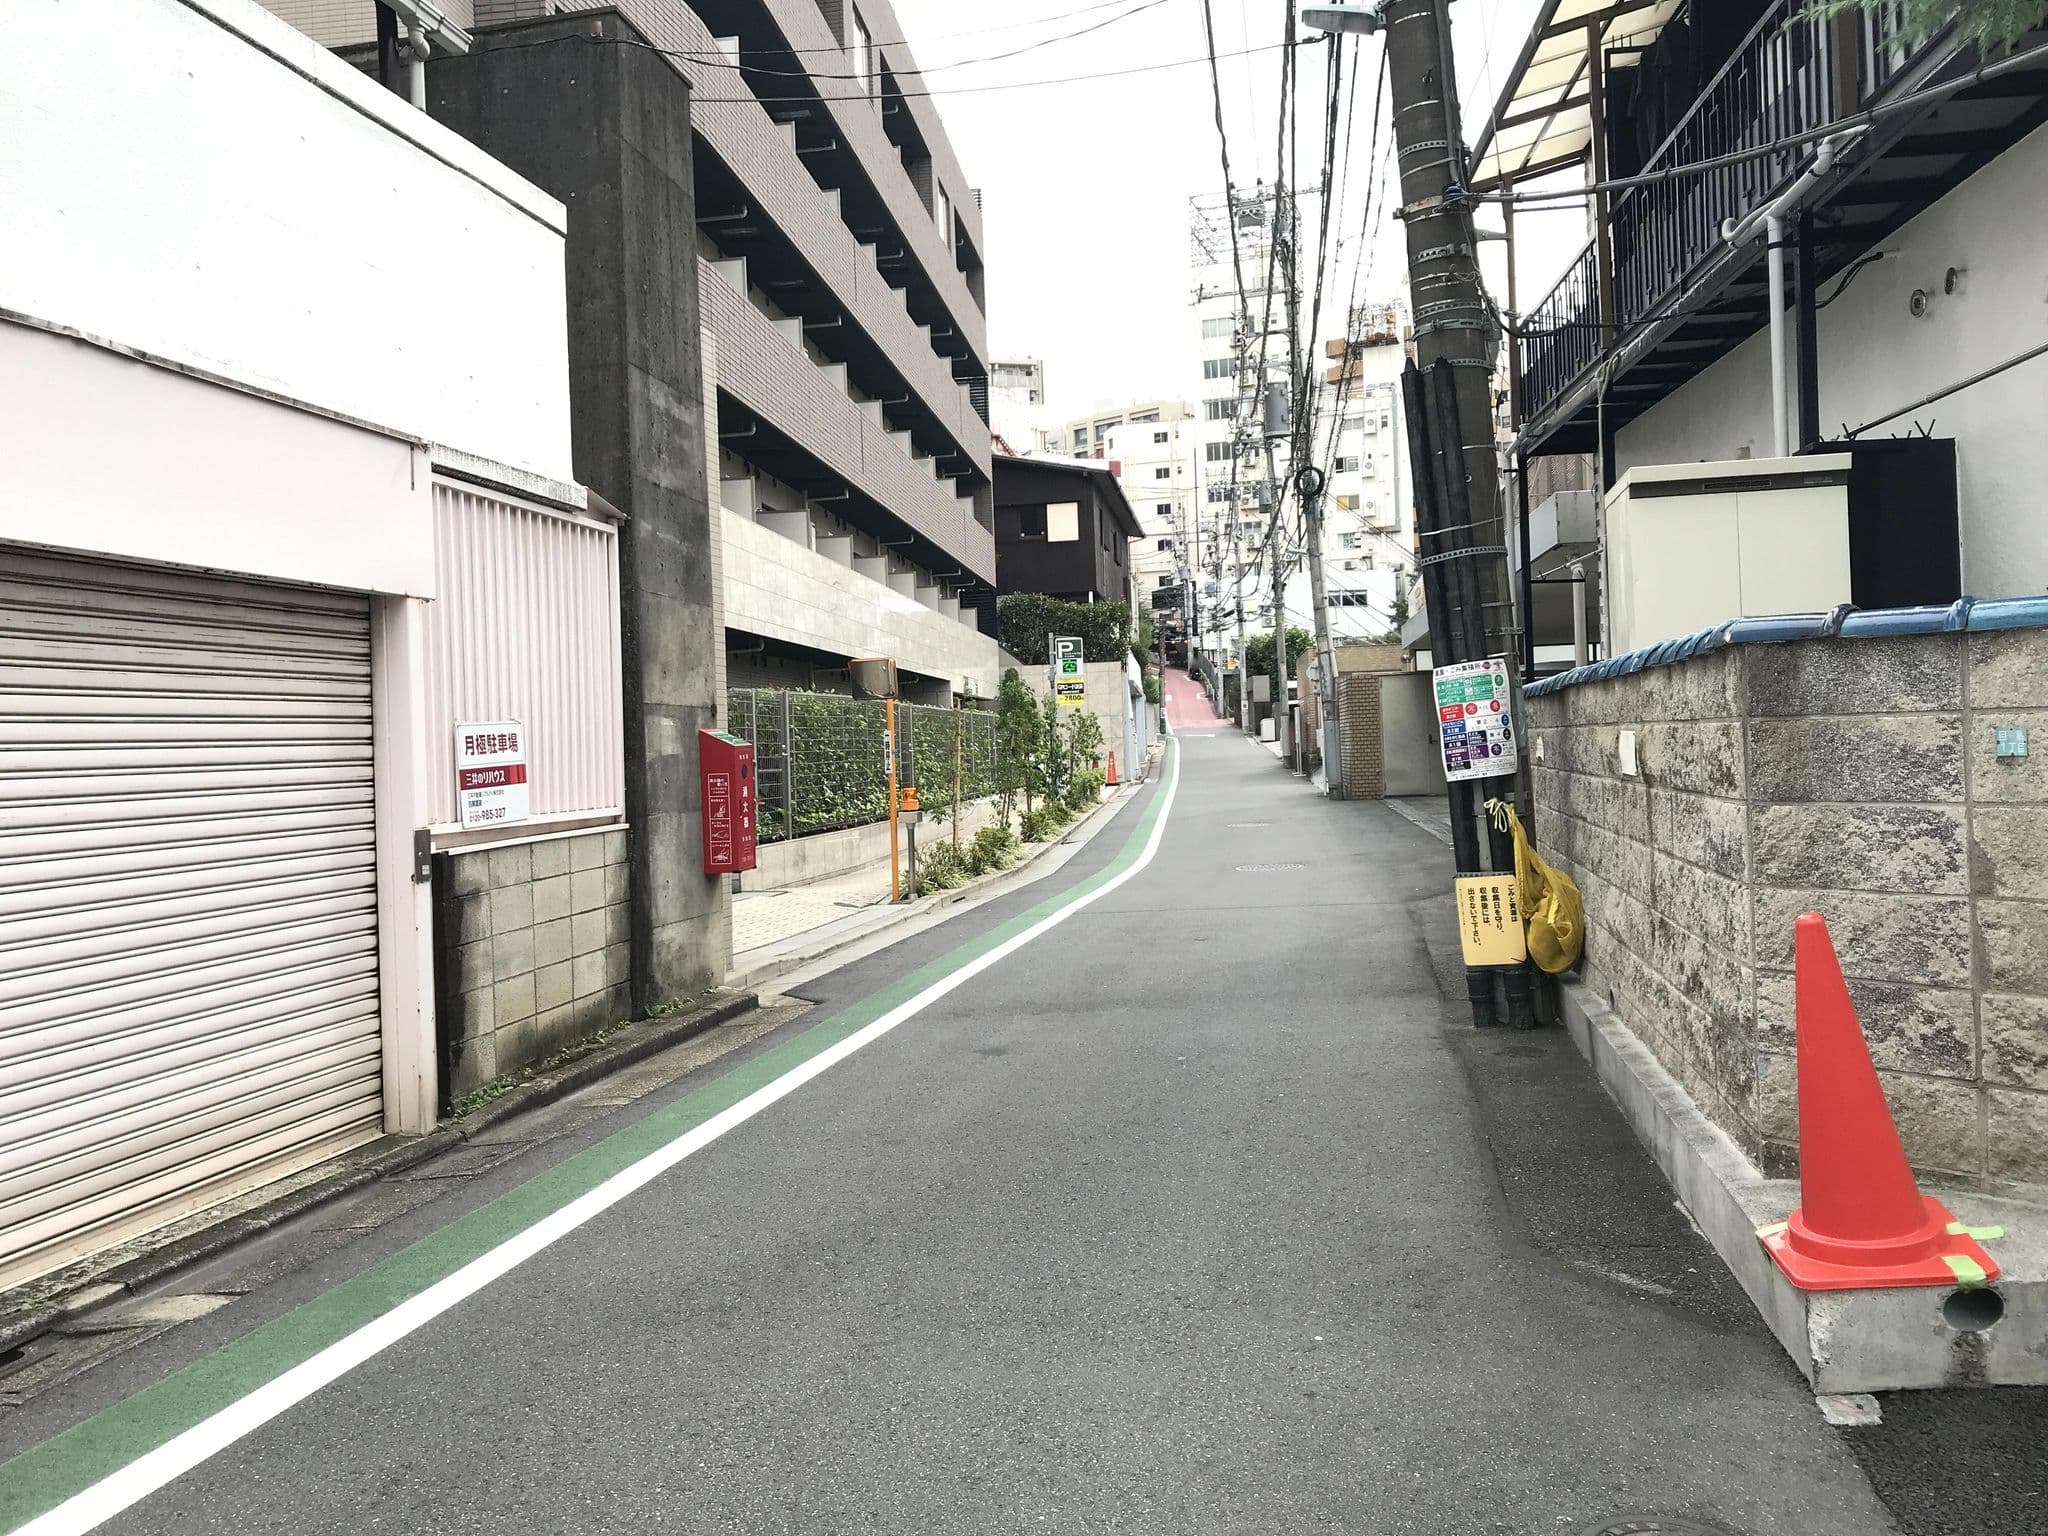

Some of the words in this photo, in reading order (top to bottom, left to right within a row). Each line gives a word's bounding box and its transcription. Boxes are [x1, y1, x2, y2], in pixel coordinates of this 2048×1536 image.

[1057, 641, 1074, 658] P
[465, 733, 518, 756] 月極駐車場
[466, 769, 506, 786] 三井のリハウス
